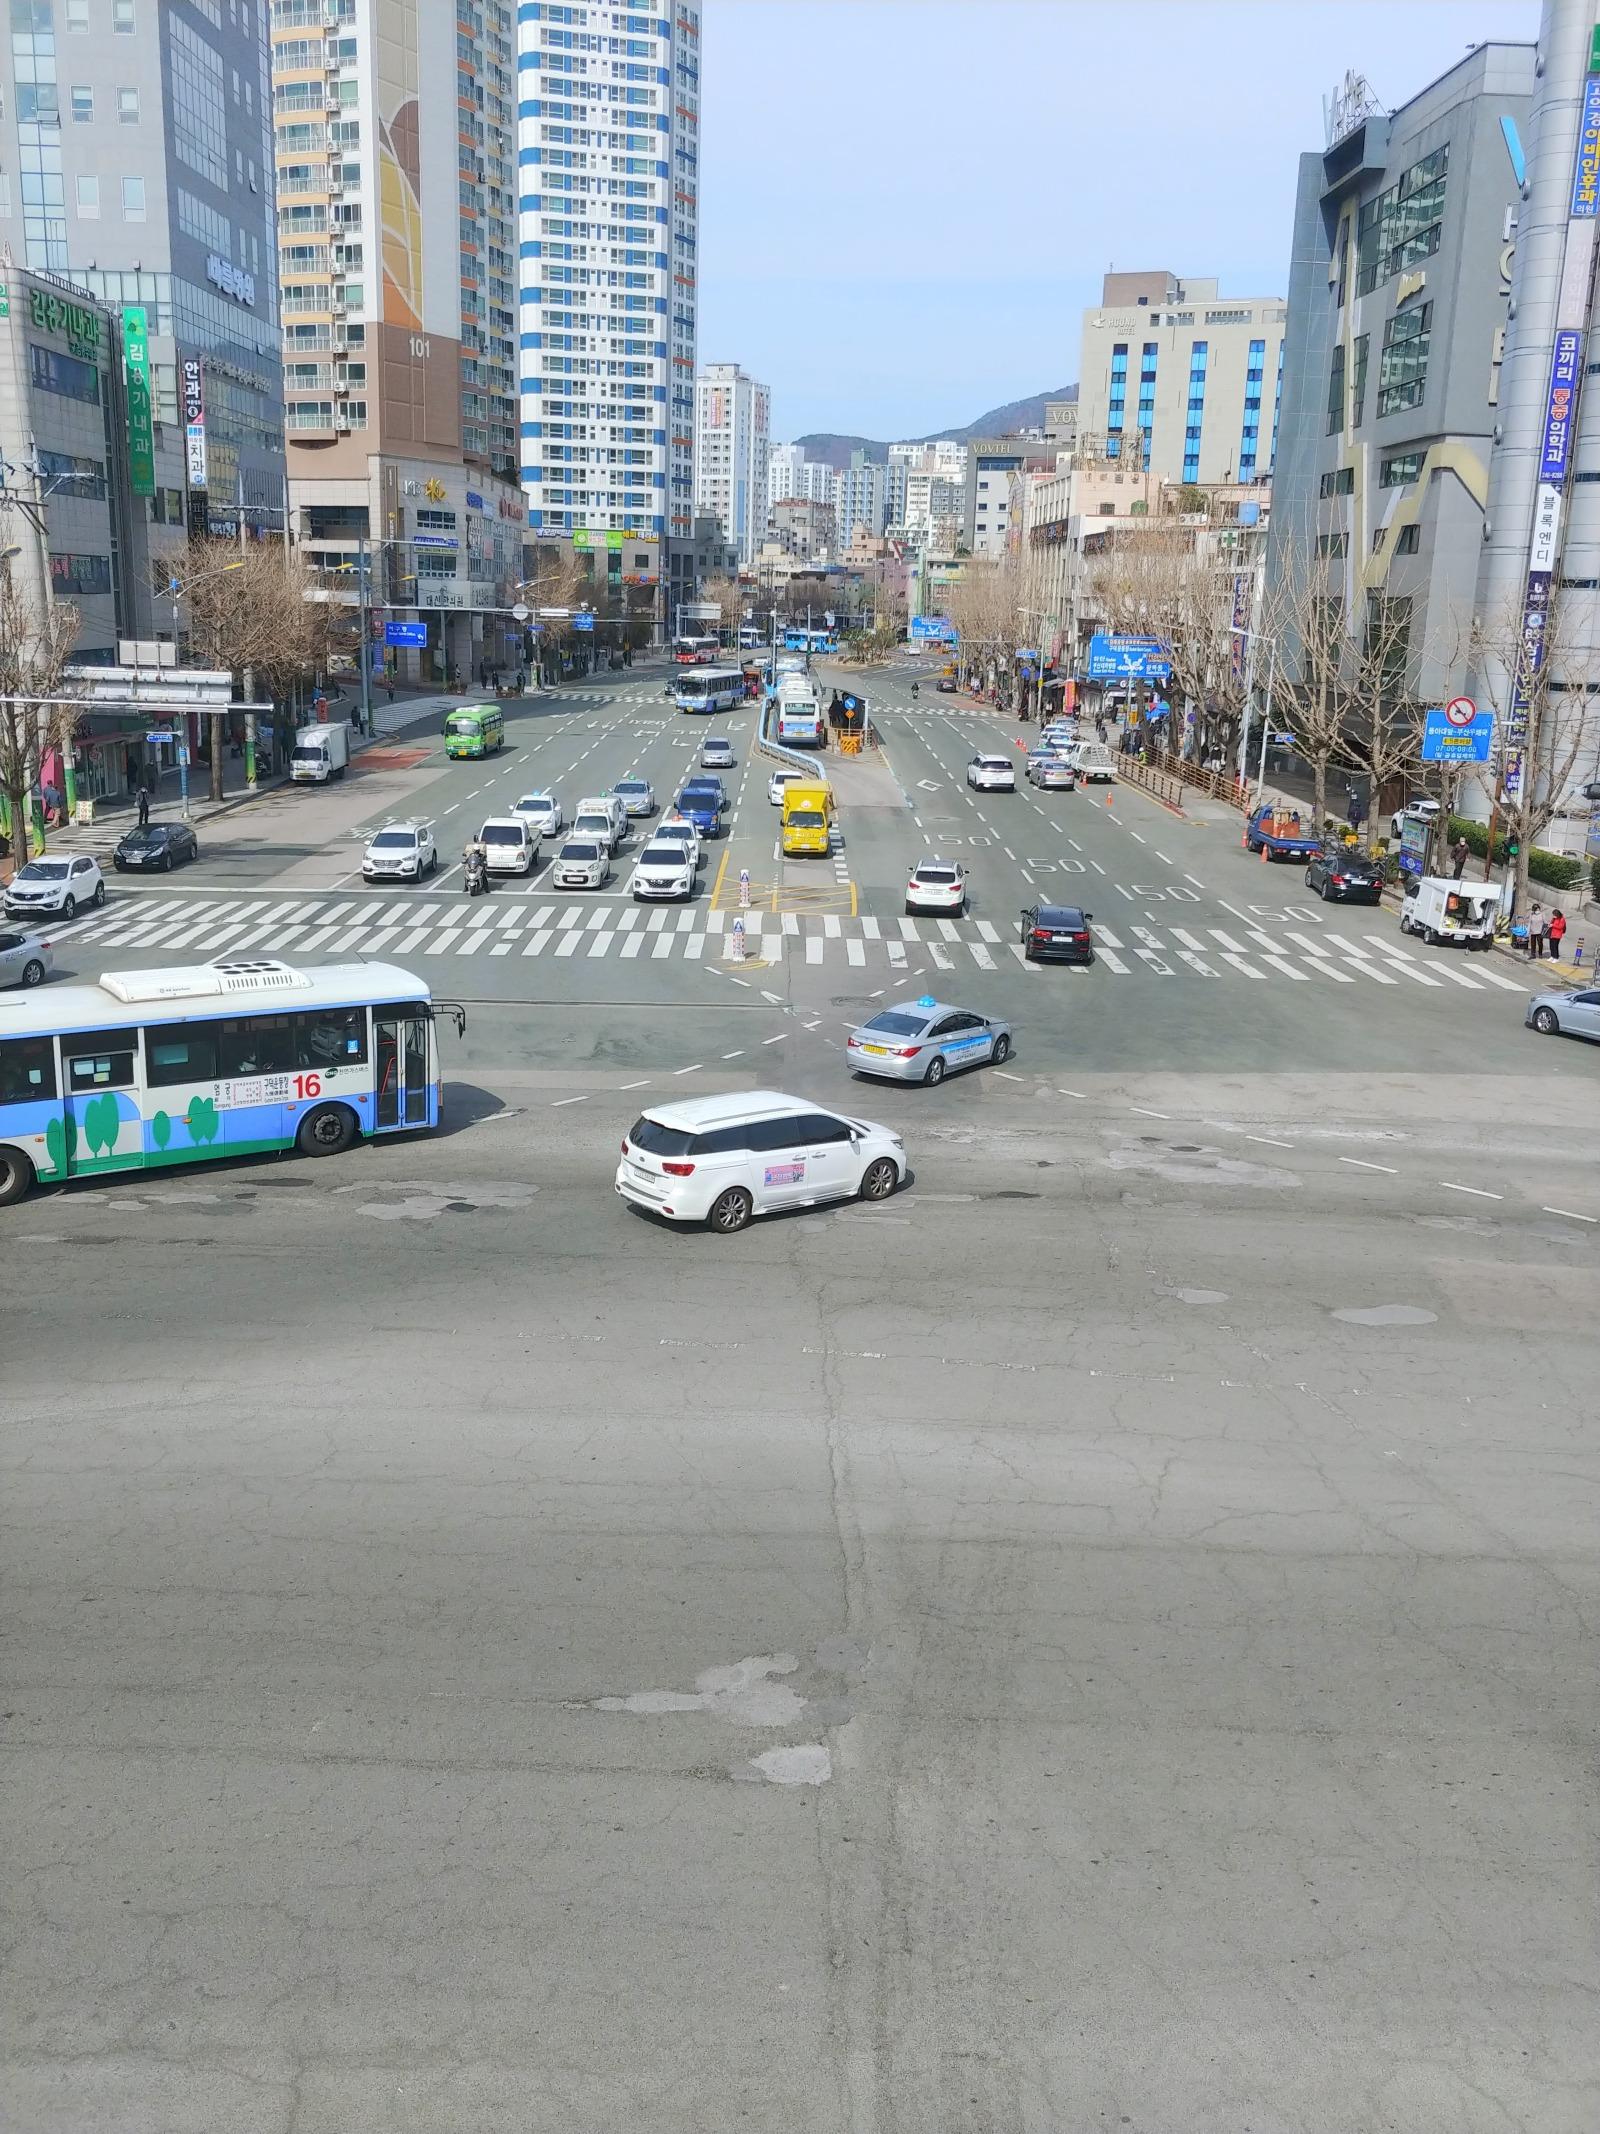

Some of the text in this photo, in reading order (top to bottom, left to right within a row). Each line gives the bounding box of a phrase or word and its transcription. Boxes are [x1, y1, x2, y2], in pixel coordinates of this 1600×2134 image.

[1575, 204, 1594, 214] 의원
[30, 288, 101, 348] 김용기내과
[409, 336, 430, 358] 101
[1556, 335, 1576, 382] 코끼리
[185, 361, 201, 399] 안과
[129, 342, 150, 454] 김용기내과
[1546, 387, 1571, 464] 통증의학과
[190, 444, 205, 475] 치과
[973, 442, 1013, 454] VOVTEL
[1537, 495, 1556, 563] 블록엔디
[938, 834, 992, 846] 50
[1027, 857, 1087, 873] 50
[1130, 884, 1201, 902] 50
[1247, 904, 1323, 923] 50
[292, 1073, 321, 1099] 16
